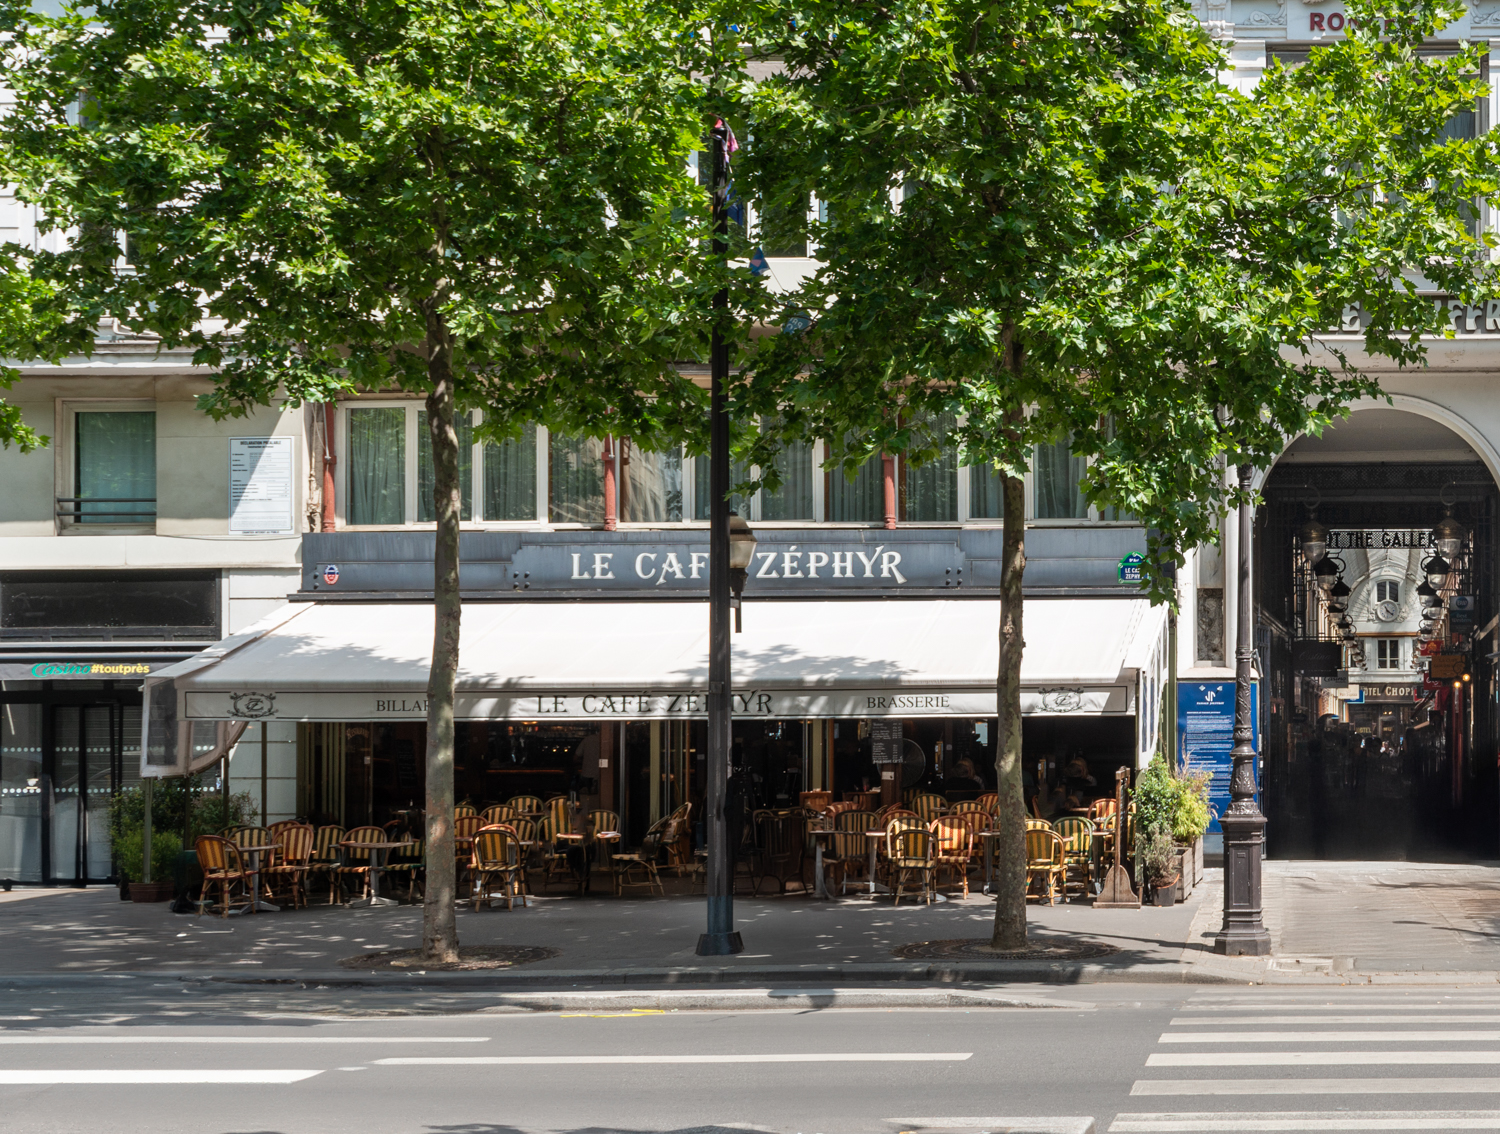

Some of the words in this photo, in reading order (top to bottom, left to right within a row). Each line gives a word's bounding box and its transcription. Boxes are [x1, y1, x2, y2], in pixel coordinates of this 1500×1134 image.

[1349, 532, 1373, 547] THE
[1382, 532, 1438, 547] GALLER
[571, 552, 615, 580] LE
[635, 552, 711, 586] CAF
[756, 545, 908, 584] ZÉPHYR
[31, 662, 91, 677] Casino
[91, 664, 149, 675] #toutprès
[1385, 686, 1414, 696] CHOPI
[376, 700, 429, 712] BILLA
[537, 694, 568, 714] LE
[581, 690, 653, 714] CAFÉ
[666, 690, 772, 714] ZÉYR
[866, 696, 950, 709] BRASSERIE
